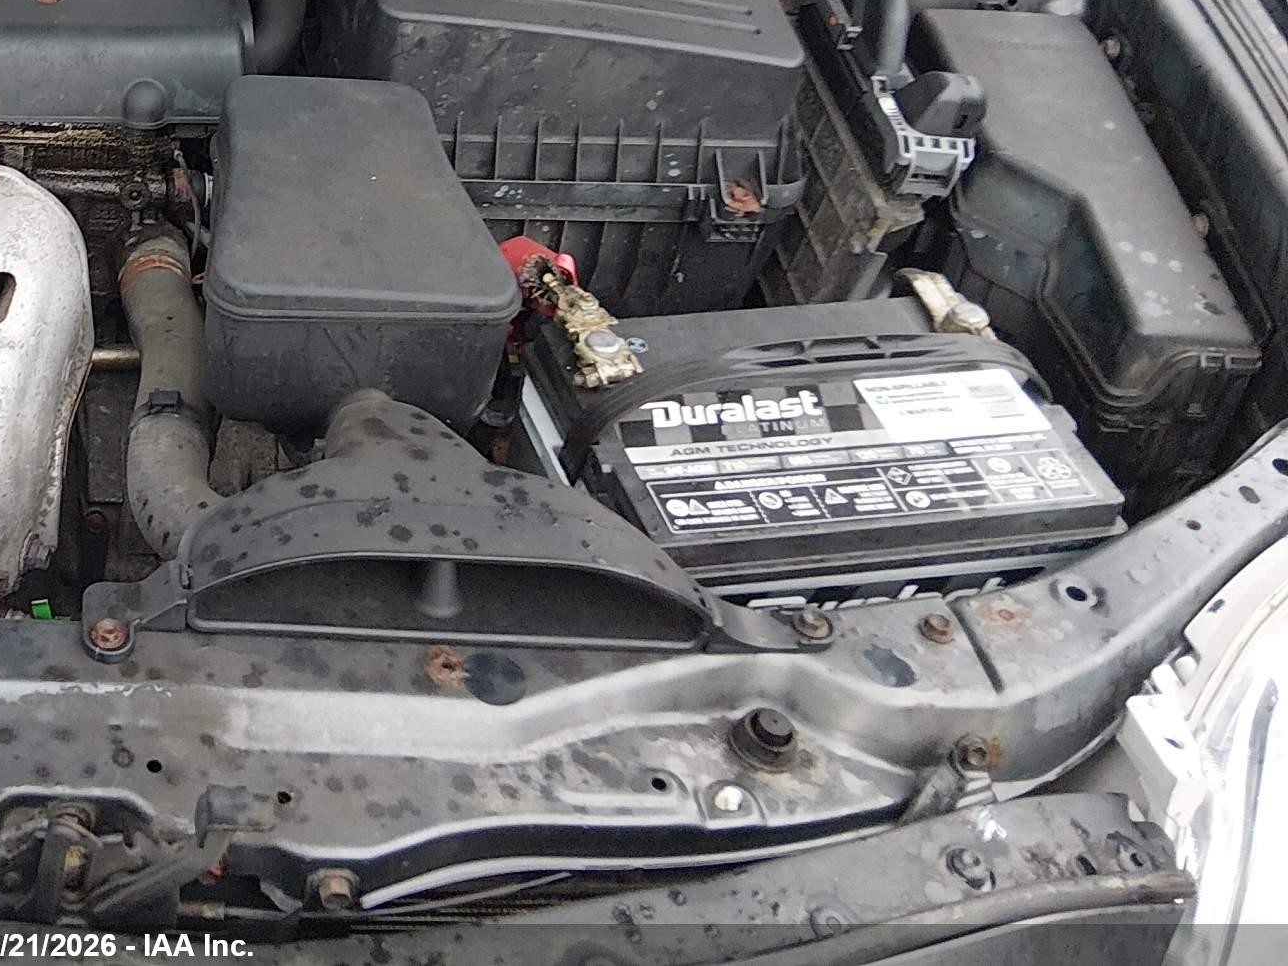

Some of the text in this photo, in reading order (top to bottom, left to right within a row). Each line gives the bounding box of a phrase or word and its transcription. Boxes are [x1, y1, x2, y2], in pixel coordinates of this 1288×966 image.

[639, 390, 824, 428] Duralast
[728, 417, 828, 434] LATINUM
[669, 436, 833, 458] AGM TECHNOLOGY
